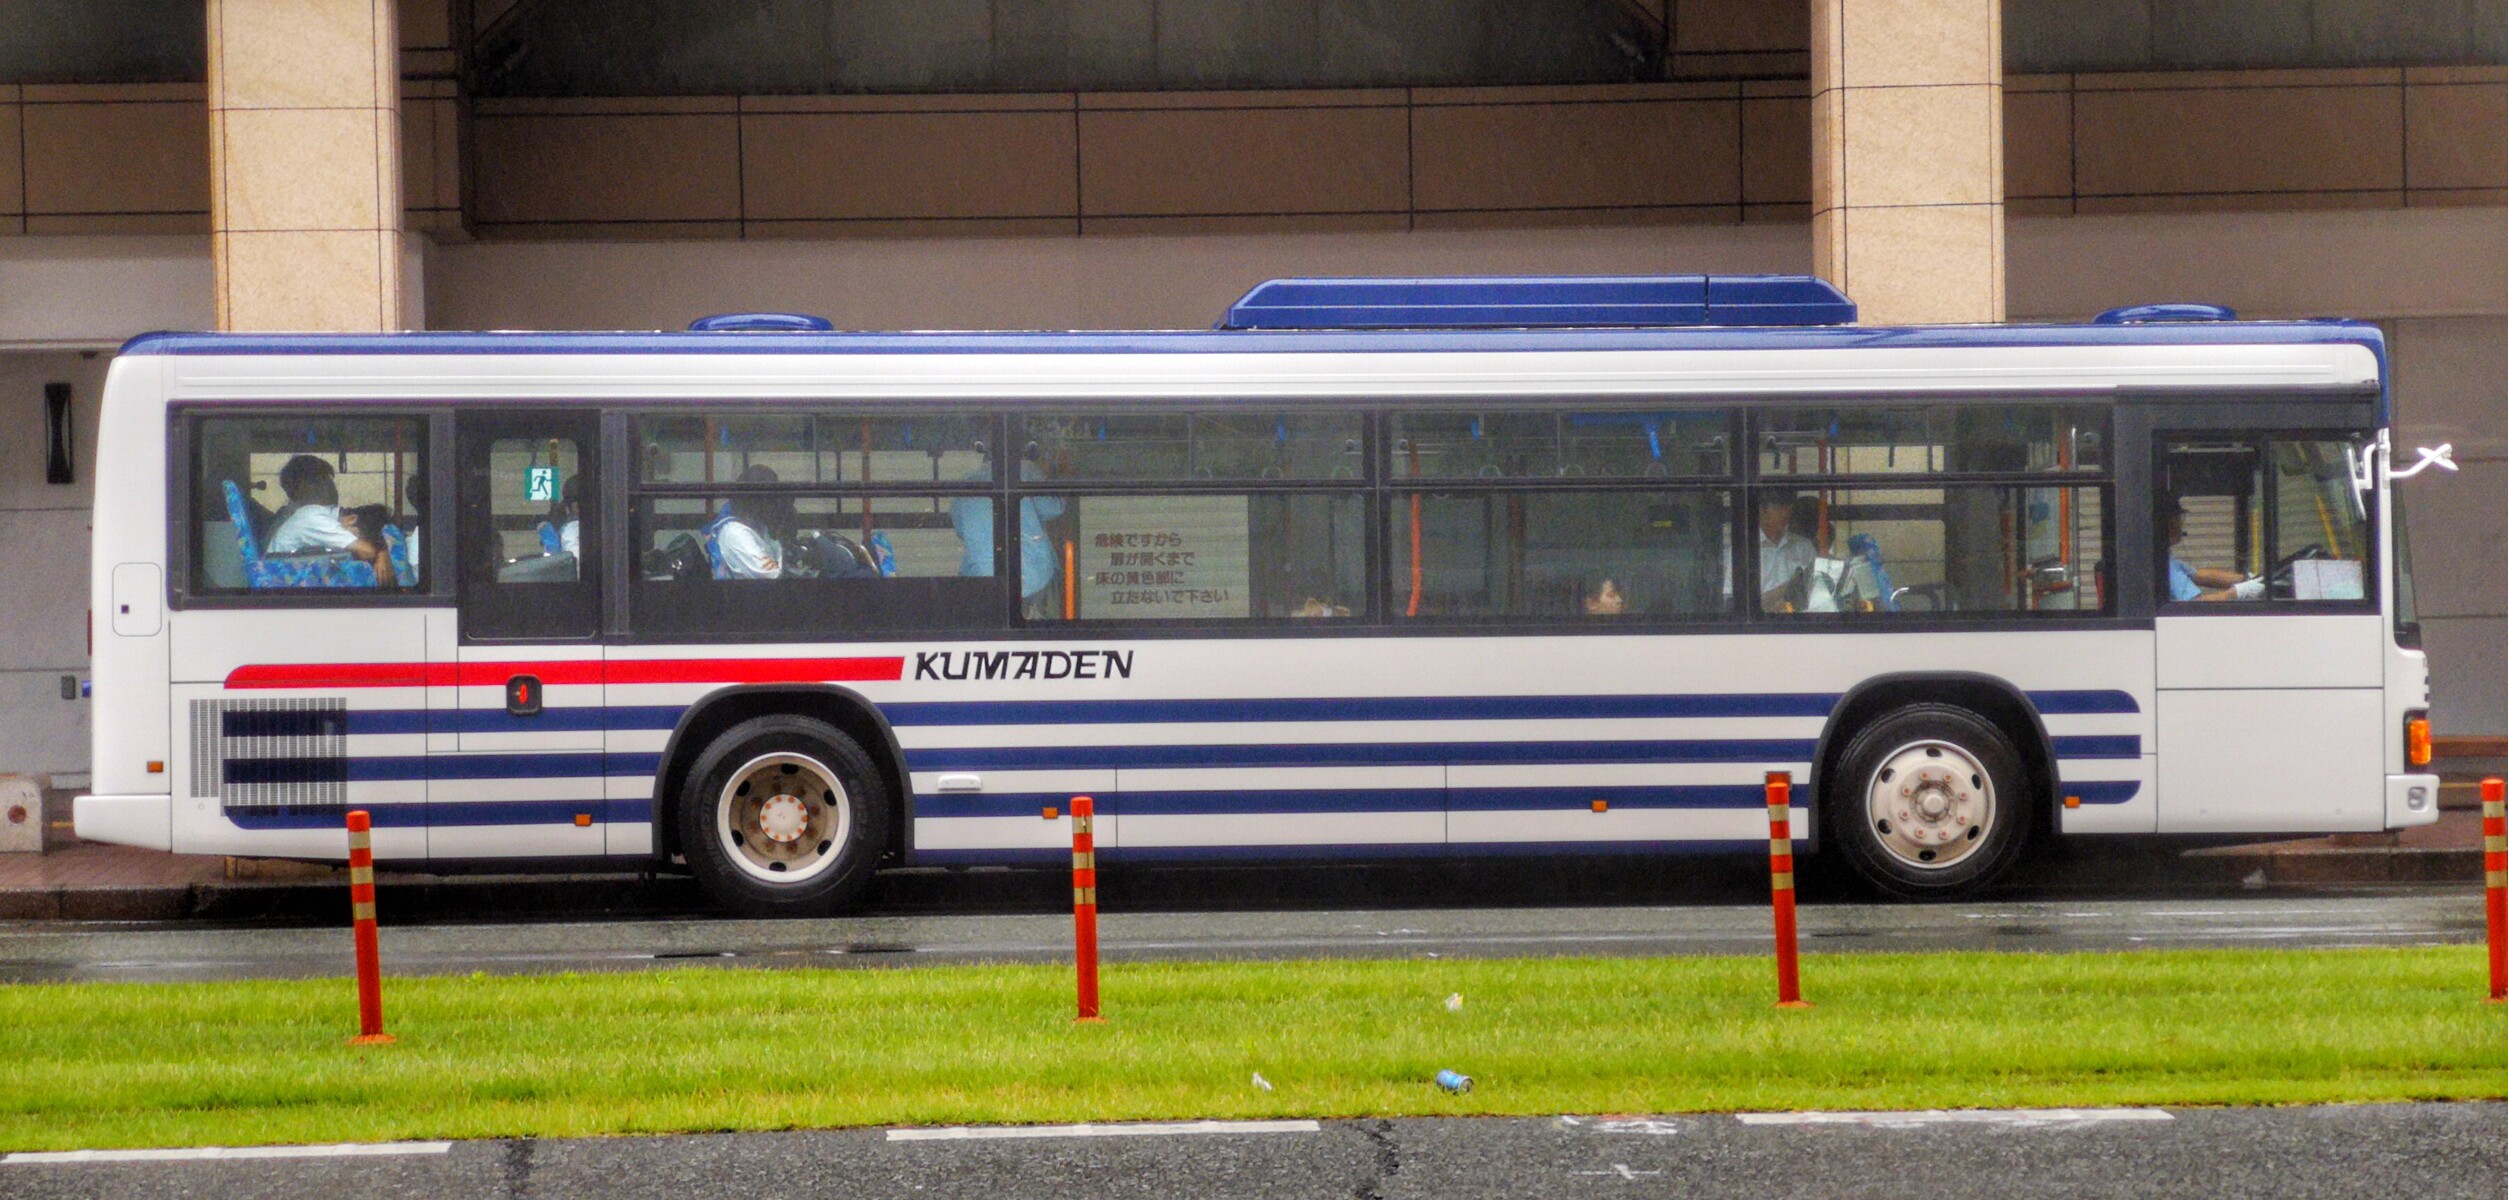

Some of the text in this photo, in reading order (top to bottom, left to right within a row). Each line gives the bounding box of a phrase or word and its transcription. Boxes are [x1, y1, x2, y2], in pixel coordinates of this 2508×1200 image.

[1096, 532, 1182, 548] 危険ですから
[1111, 552, 1195, 566] 扉が開くまで
[1111, 589, 1230, 604] 立たないで下さい
[915, 650, 1134, 681] KUMADEN
